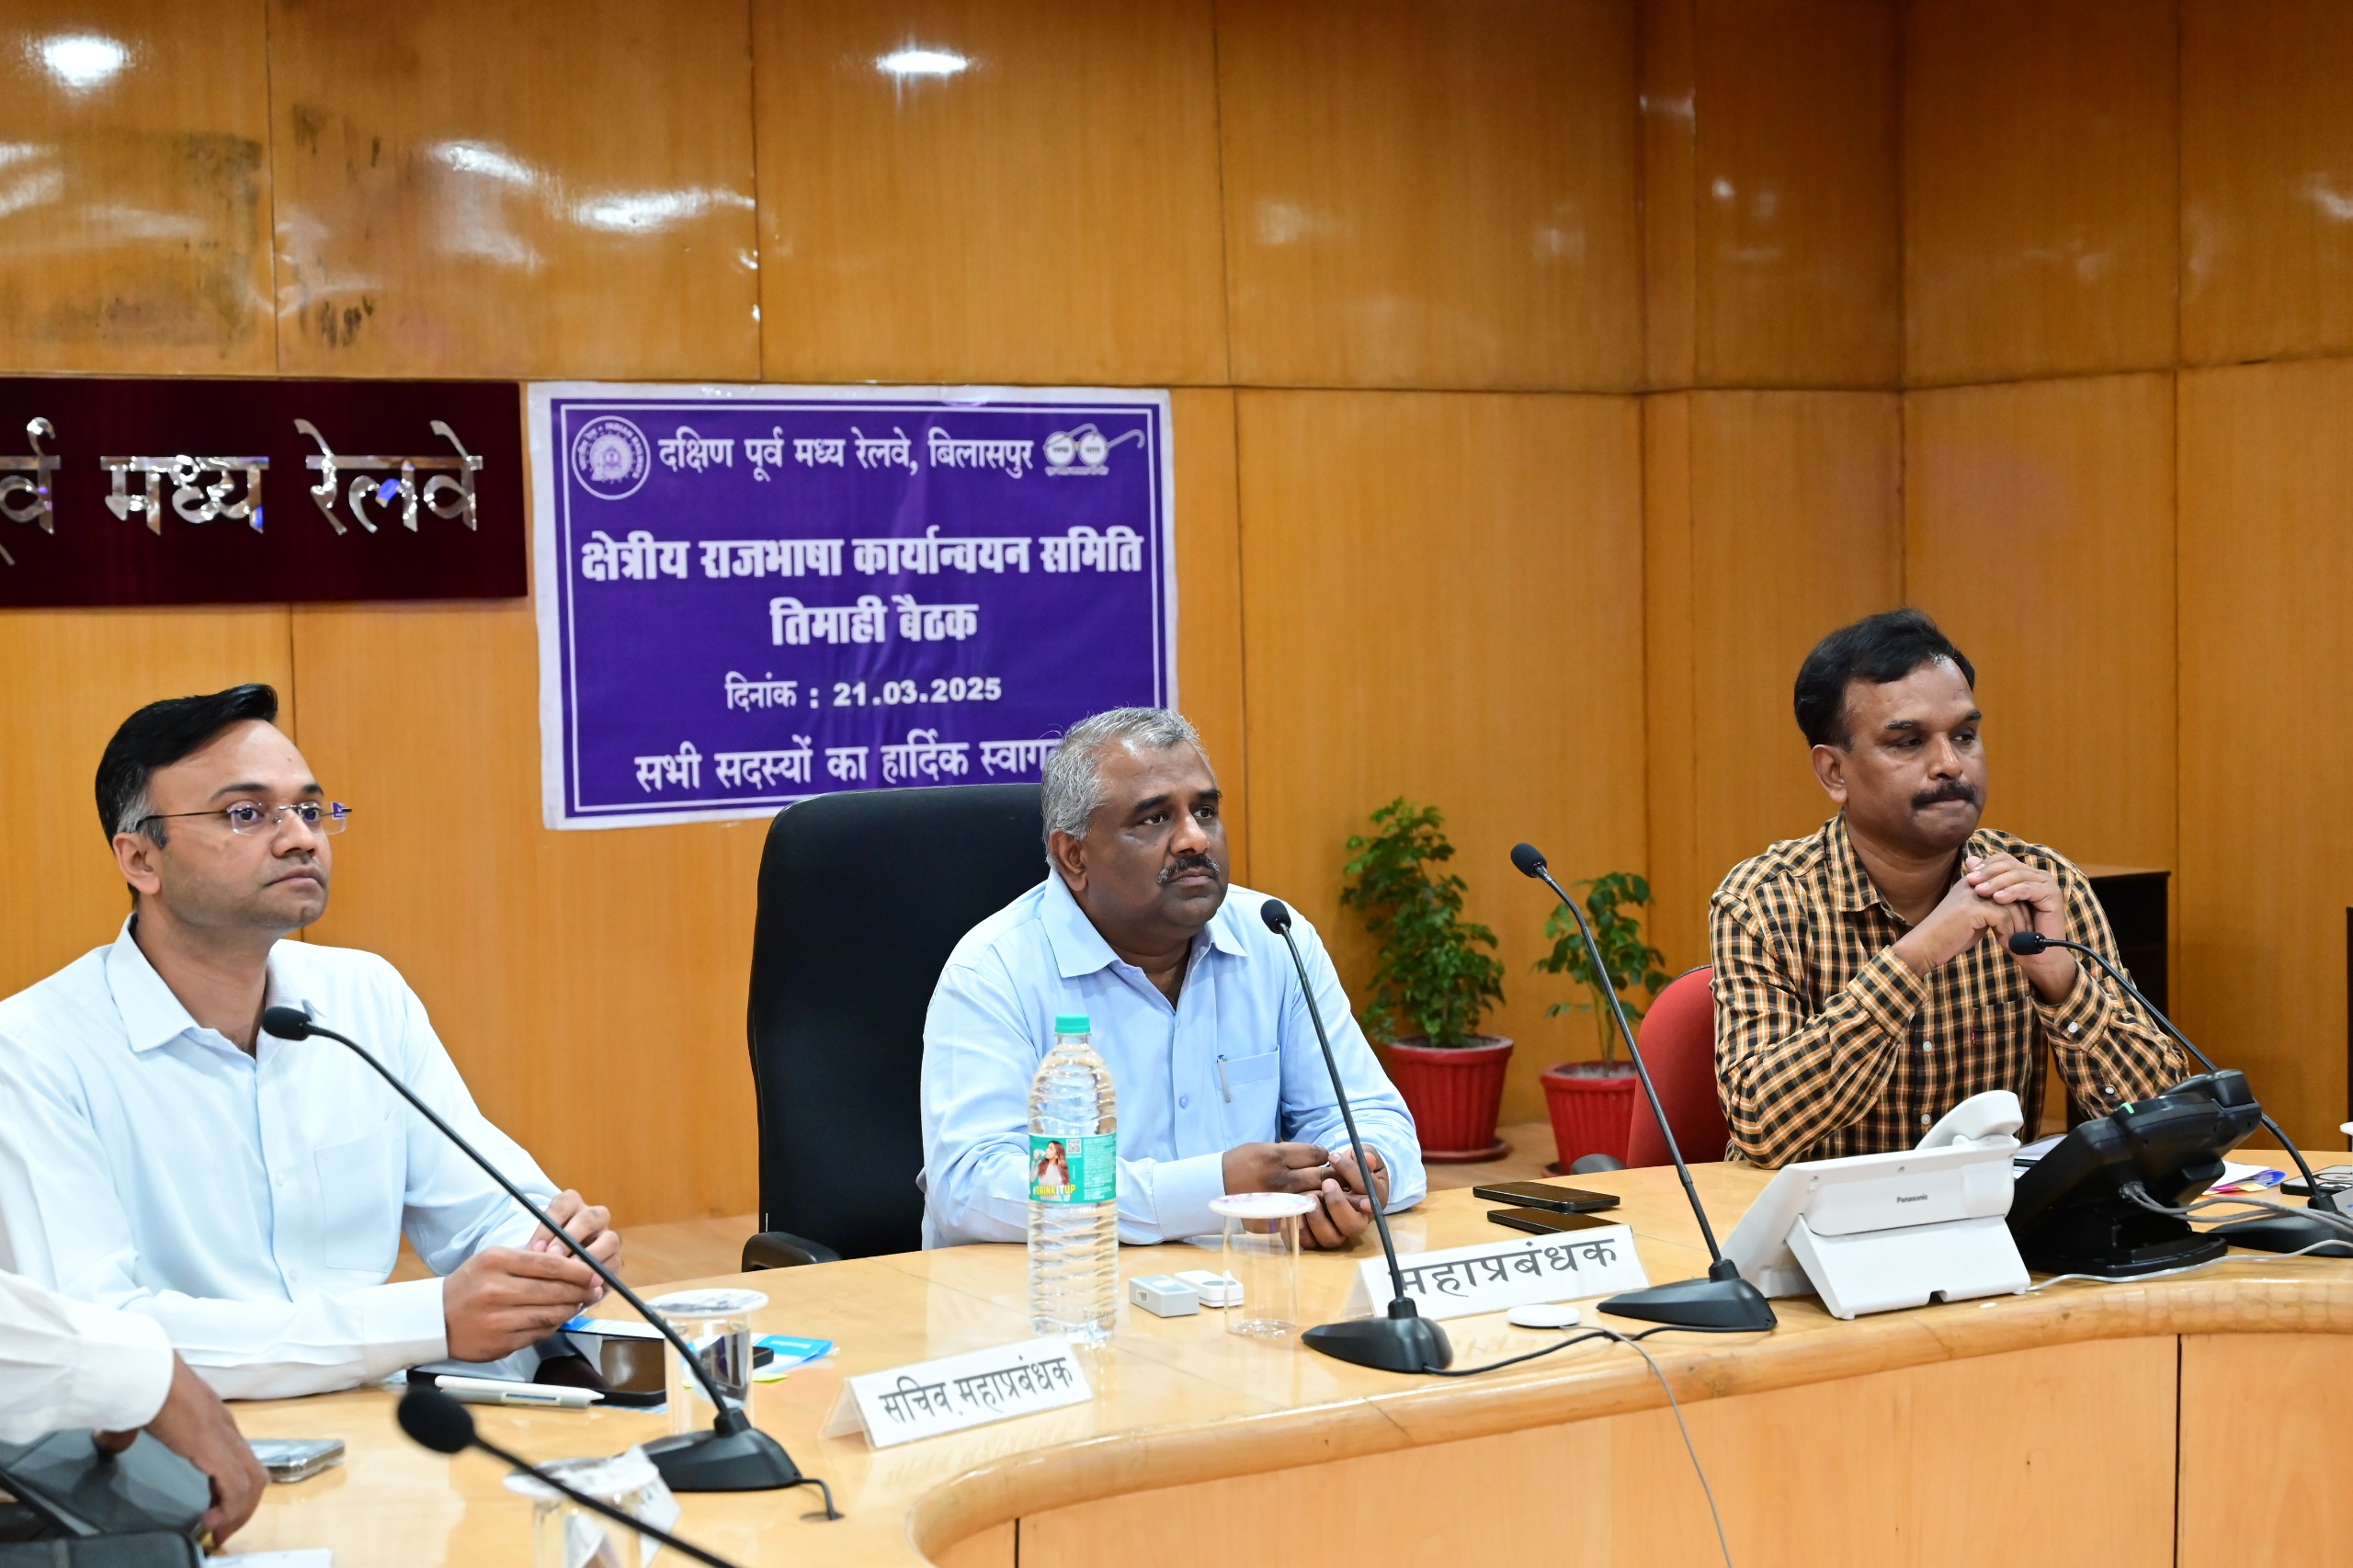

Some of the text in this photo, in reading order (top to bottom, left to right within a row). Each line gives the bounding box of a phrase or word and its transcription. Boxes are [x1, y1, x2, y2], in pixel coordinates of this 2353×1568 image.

[100, 454, 269, 535] मध्य
[294, 418, 483, 535] रेलवे
[657, 426, 734, 473] दक्षिण
[744, 426, 784, 482] पूर्व
[793, 437, 846, 467] मध्य
[851, 426, 918, 475] रेलवे,
[927, 426, 1034, 479] बिलासपुर
[581, 525, 1144, 581] क्षेत्रीय राजभाषा कार्यान्वयन समिति
[769, 594, 979, 645] तिमाही बैठक
[724, 670, 798, 712] दिनांक
[833, 676, 1002, 707] 21.03.2025
[634, 728, 1063, 793] सभी सदस्यों का हार्दिक स्वाग
[1896, 1194, 1928, 1203] Panasonic
[1388, 1239, 1617, 1298] महाप्रबंधक
[953, 1355, 1074, 1414] महाप्रबंधक
